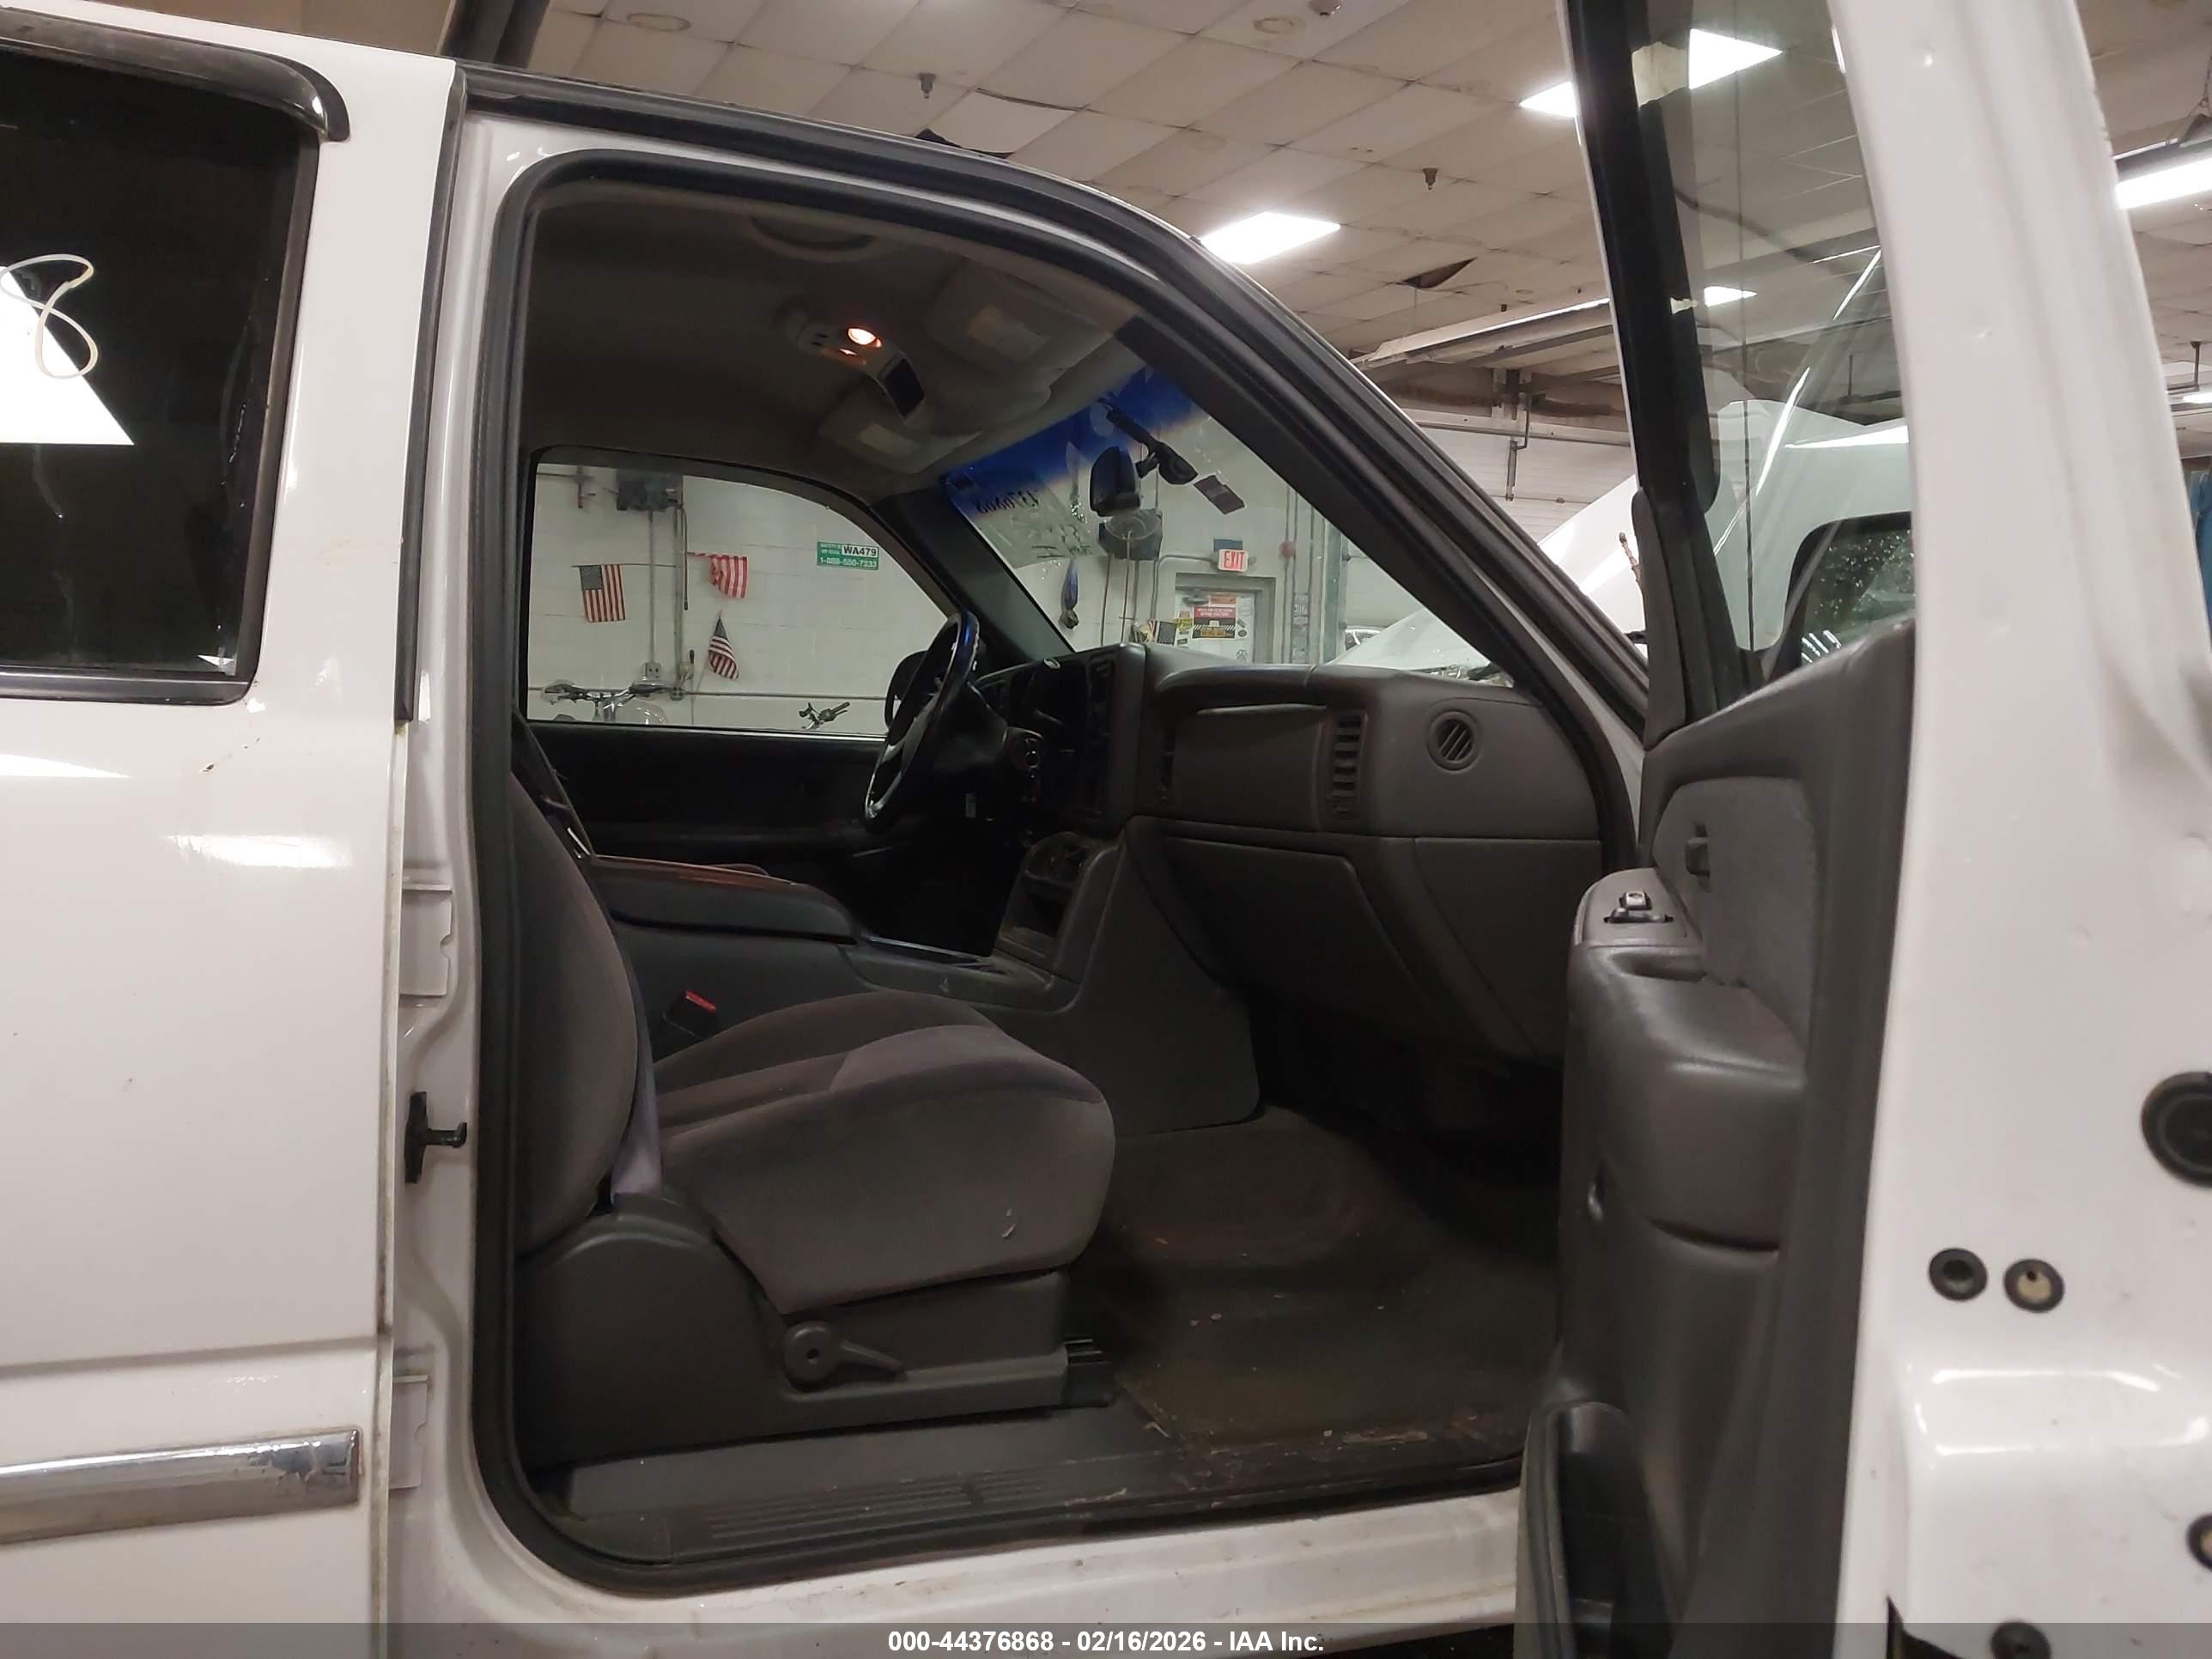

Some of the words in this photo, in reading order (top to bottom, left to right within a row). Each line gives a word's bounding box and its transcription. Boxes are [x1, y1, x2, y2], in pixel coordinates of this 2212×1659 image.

[0, 254, 99, 379] 8
[843, 545, 877, 556] WA479
[1224, 550, 1245, 570] EXIT
